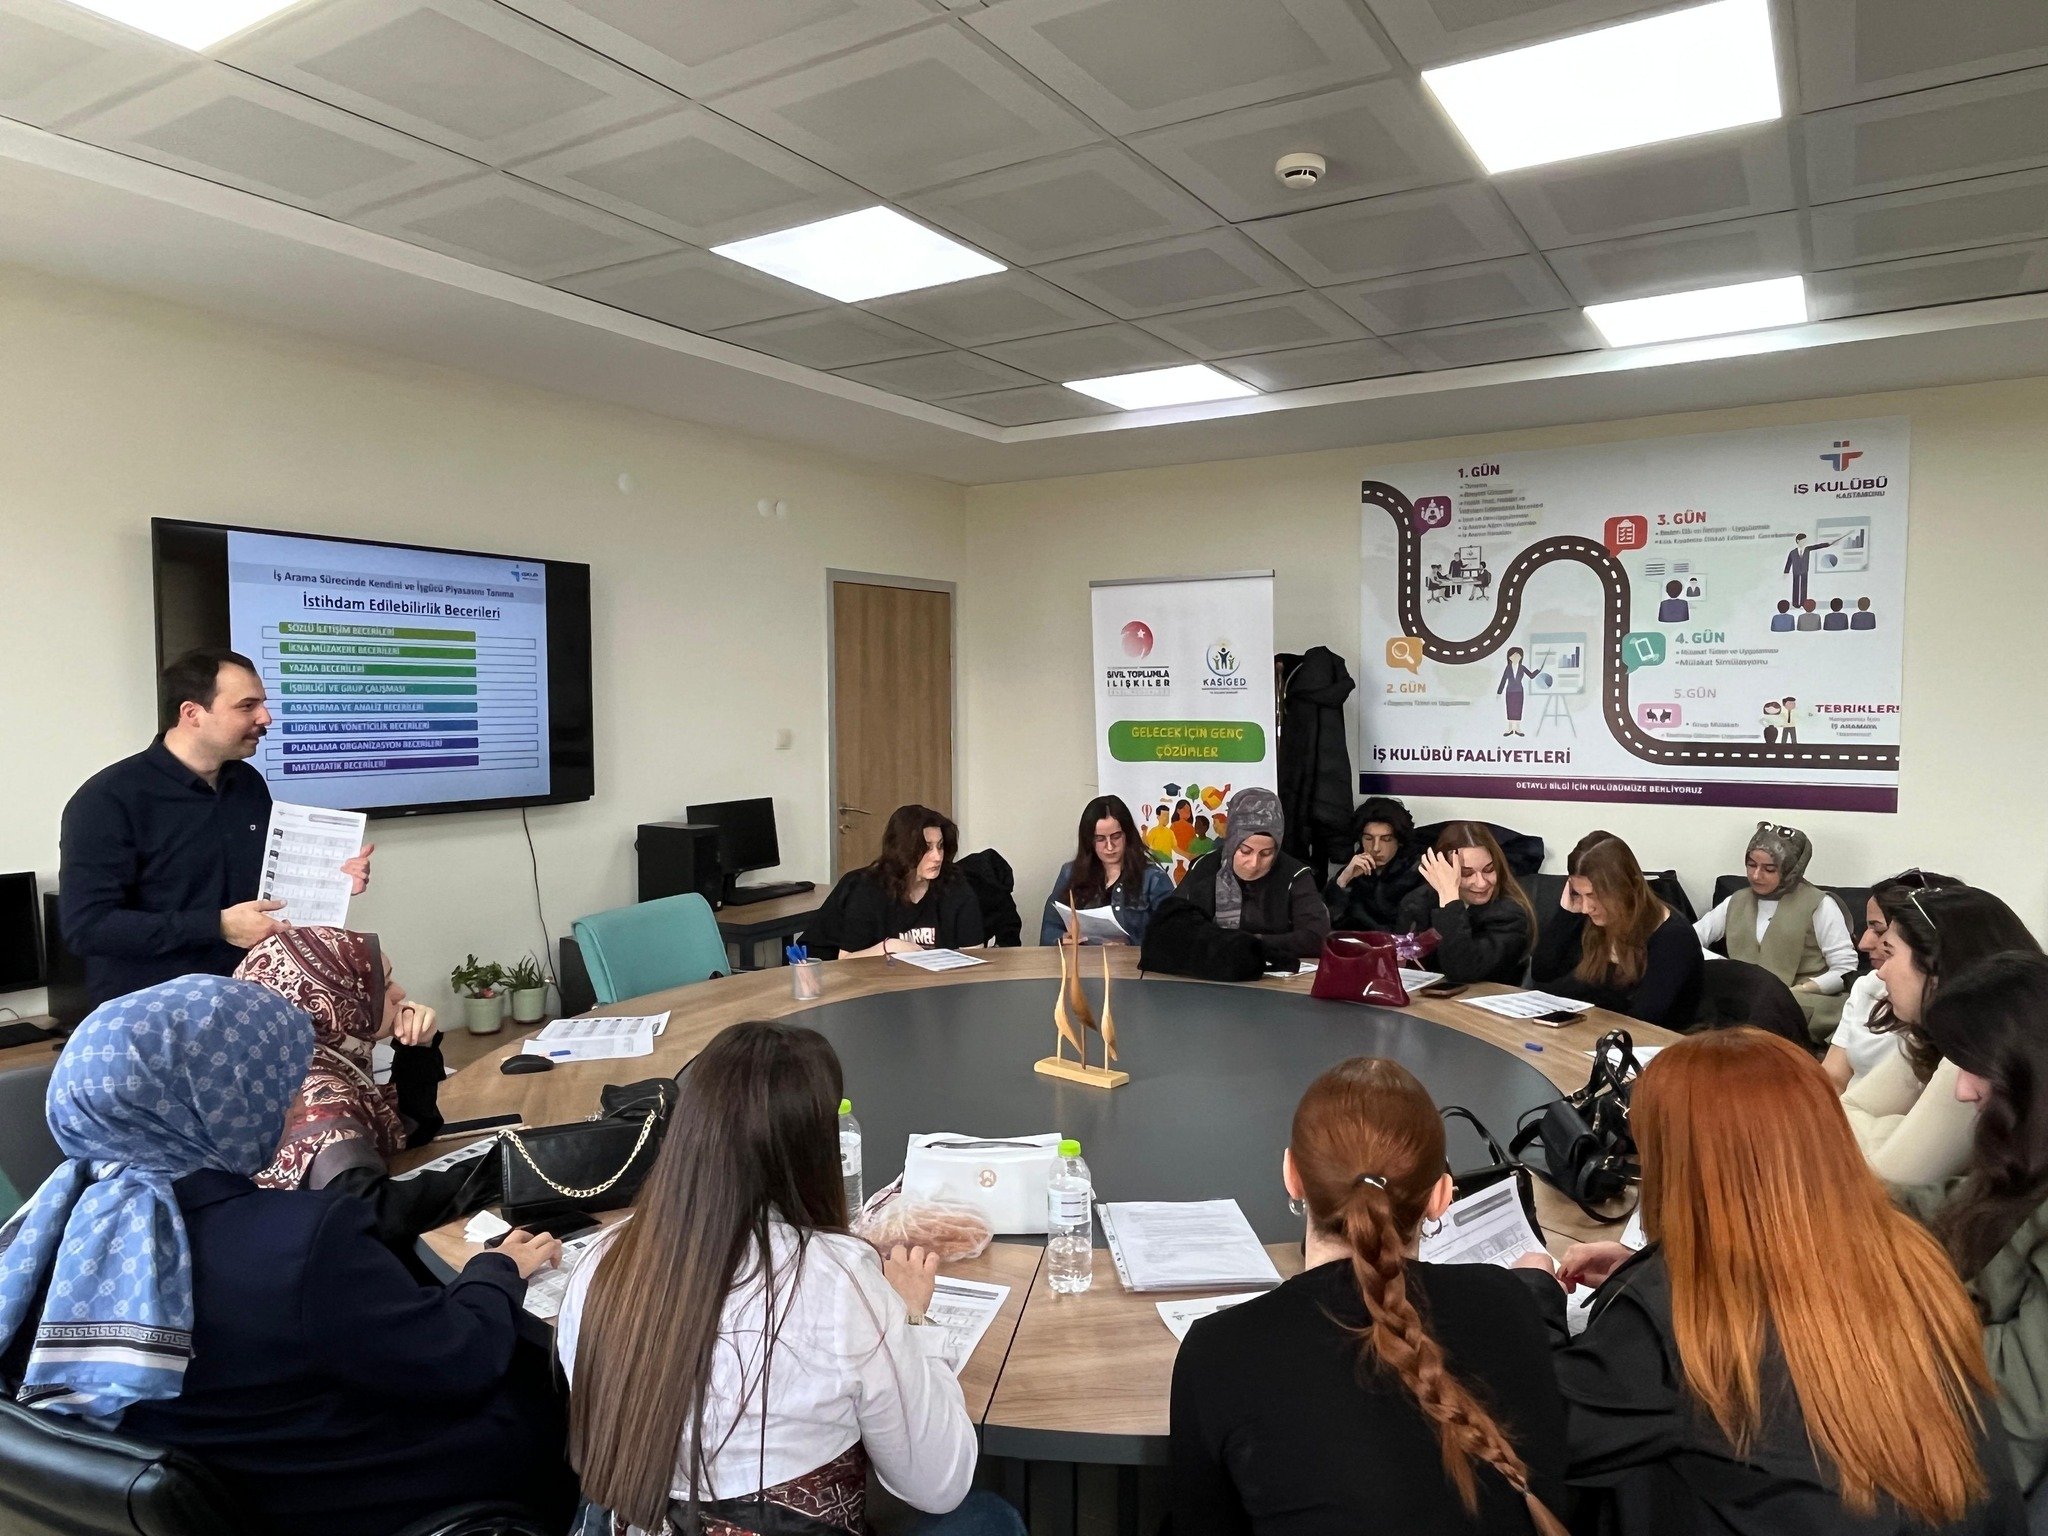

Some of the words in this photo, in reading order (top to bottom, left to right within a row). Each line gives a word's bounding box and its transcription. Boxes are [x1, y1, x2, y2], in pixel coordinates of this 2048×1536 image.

[1458, 468, 1468, 478] 1.
[1471, 463, 1500, 478] GÜN
[1814, 476, 1888, 492] KULÜBÜ
[1657, 514, 1670, 526] 3.
[1673, 509, 1706, 525] GÜN
[273, 569, 282, 581] İş
[284, 572, 317, 583] Arama
[320, 574, 366, 587] Sürecinde
[369, 579, 402, 590] Kendini
[405, 583, 414, 591] ve
[417, 581, 444, 594] İşgücü
[445, 585, 484, 596] Piyasasını
[487, 588, 514, 598] Tanıma
[303, 590, 365, 611] İstihdam
[369, 598, 441, 616] Edilebilirlik
[444, 604, 500, 619] Becerileri
[1675, 632, 1689, 644] 4.
[1691, 629, 1725, 644] GÜN
[288, 663, 319, 672] YAZMA
[1715, 658, 1769, 667] Simülasyonu
[1127, 669, 1170, 679] TOPLUMLA
[328, 683, 339, 692] VE
[341, 683, 363, 693] GRUP
[1399, 680, 1427, 694] GÜN
[290, 703, 340, 713] ARAŞTIRMA
[342, 703, 351, 712] VE
[290, 722, 327, 732] LİDERLİK
[328, 723, 339, 731] VE
[1131, 726, 1181, 738] GELECEK
[1184, 725, 1208, 741] İÇİN
[1210, 727, 1244, 741] GENÇ
[291, 742, 338, 752] PLANLAMA
[1156, 743, 1219, 759] ÇÖZÜMLER
[1372, 744, 1387, 763] İŞ
[1389, 745, 1452, 762] KULÜBÜ
[1456, 746, 1571, 764] FAALİYETLERİ
[1516, 781, 1547, 790] DETAYLI
[1549, 781, 1570, 791] BİLGİ
[1571, 781, 1588, 791] İÇİN
[1590, 782, 1647, 793] KULÜBÜMÜZE
[1649, 784, 1703, 794] BEKLİYORUZ
